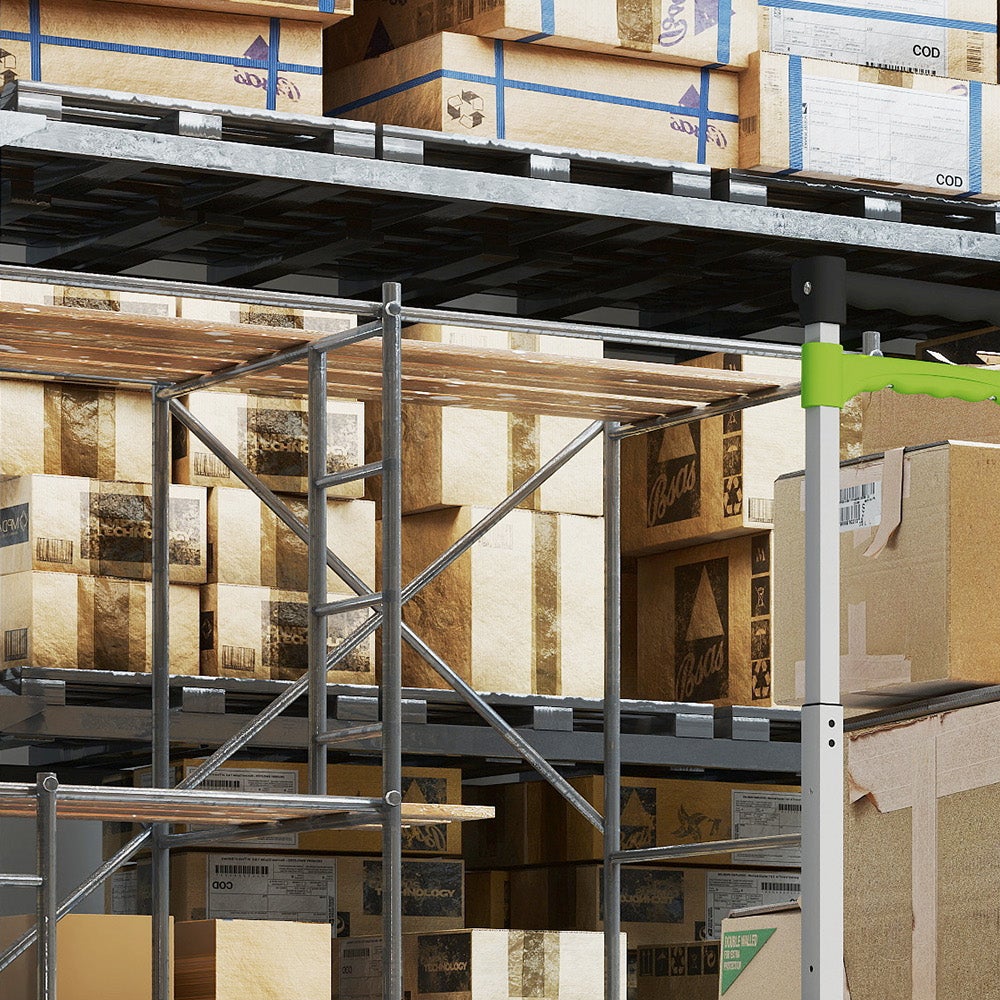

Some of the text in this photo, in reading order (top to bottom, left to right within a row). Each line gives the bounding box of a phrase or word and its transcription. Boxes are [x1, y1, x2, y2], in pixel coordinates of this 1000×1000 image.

[912, 43, 941, 59] COD
[936, 173, 963, 188] COD
[374, 888, 456, 898] THNOLOGY
